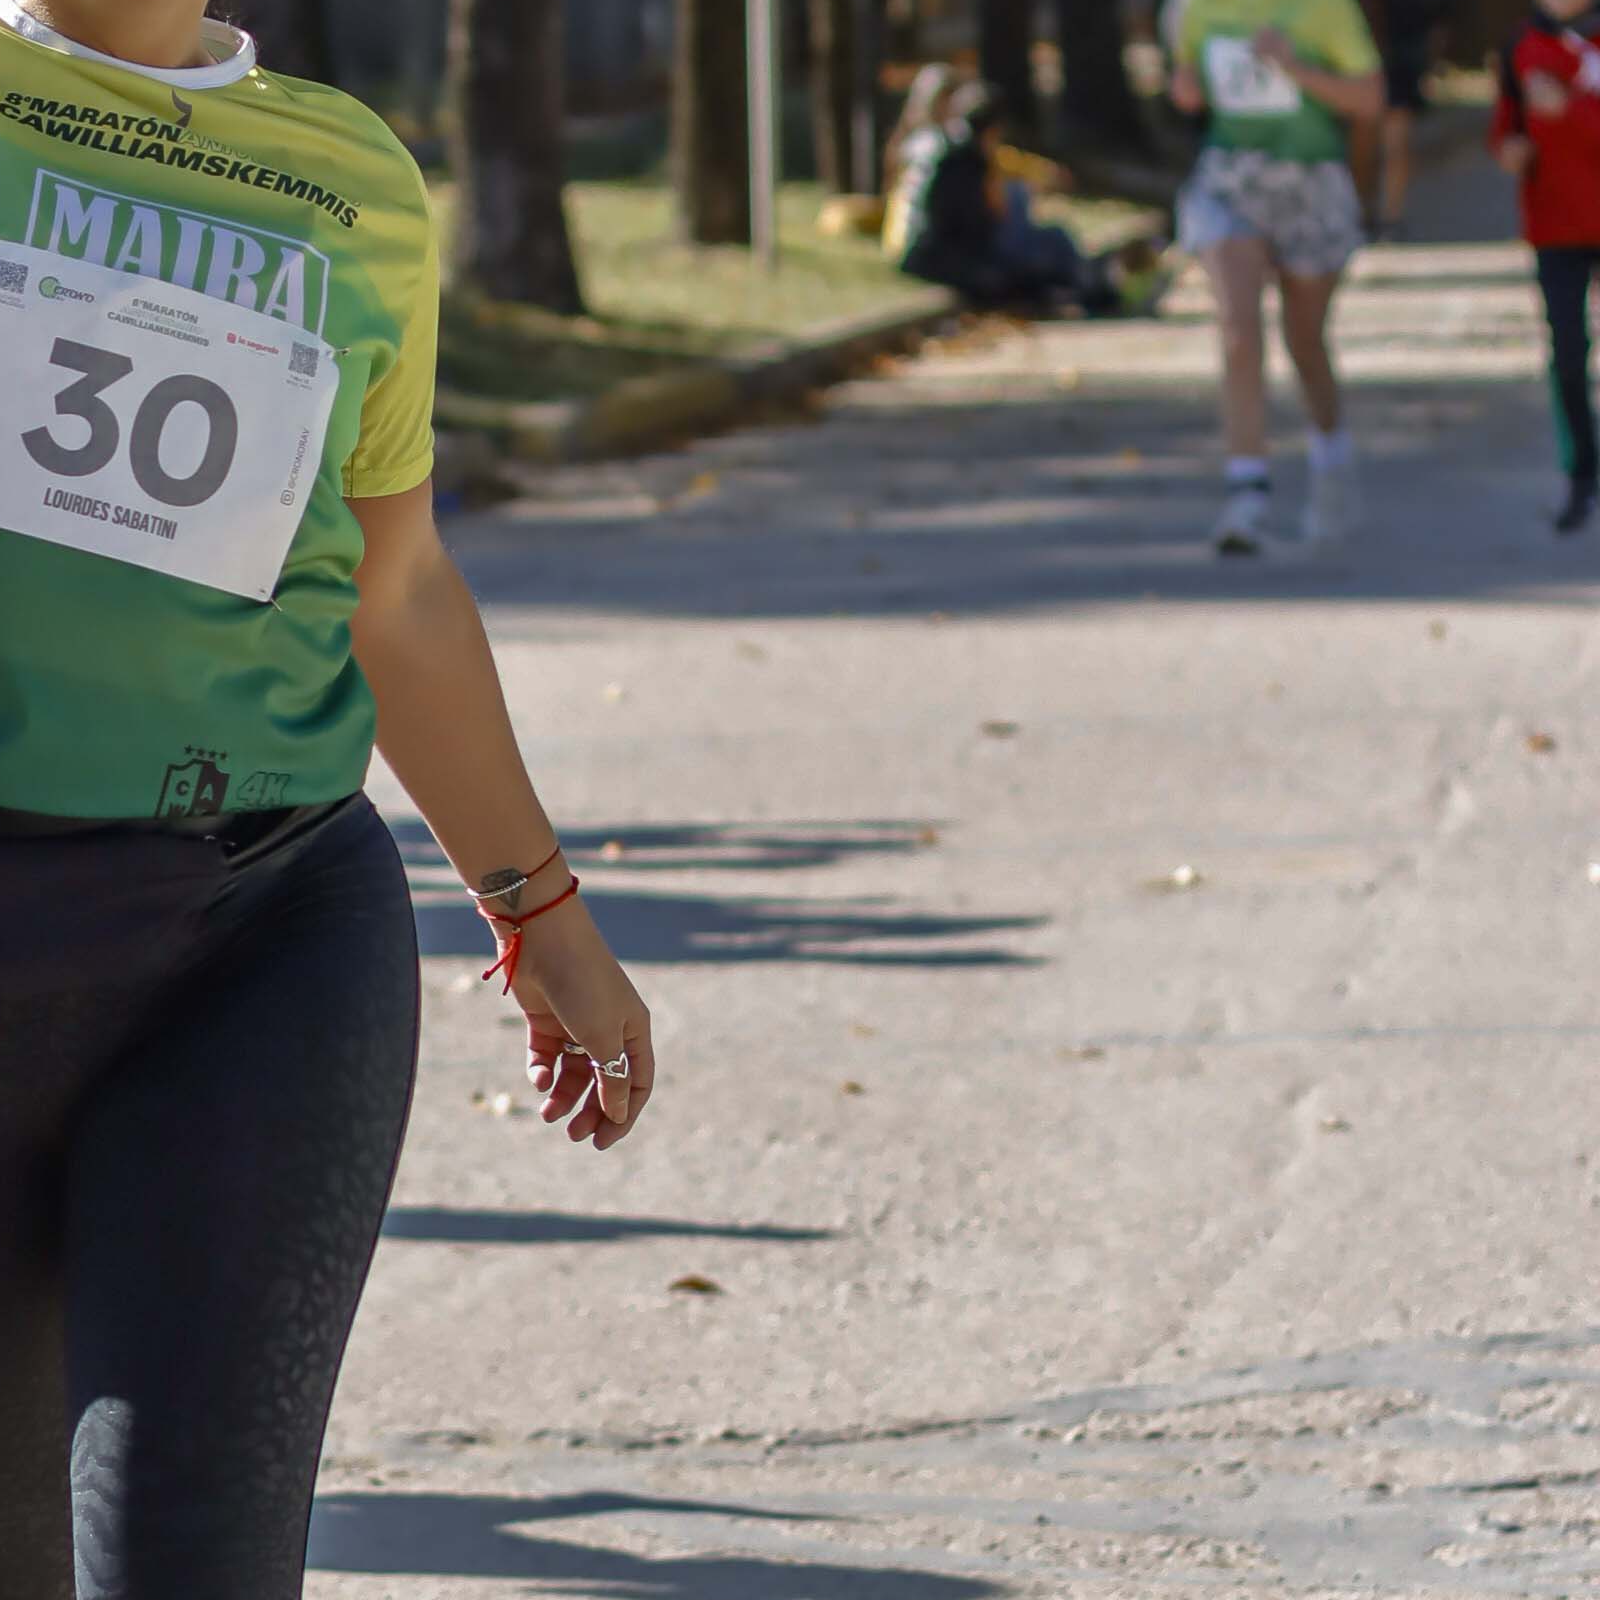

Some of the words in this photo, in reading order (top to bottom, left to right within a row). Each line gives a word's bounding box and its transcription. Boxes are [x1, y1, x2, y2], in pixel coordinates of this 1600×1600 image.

[48, 183, 304, 329] MAIRA
[20, 337, 238, 507] 30
[43, 487, 111, 521] LOURDES
[111, 505, 179, 540] SABATINI
